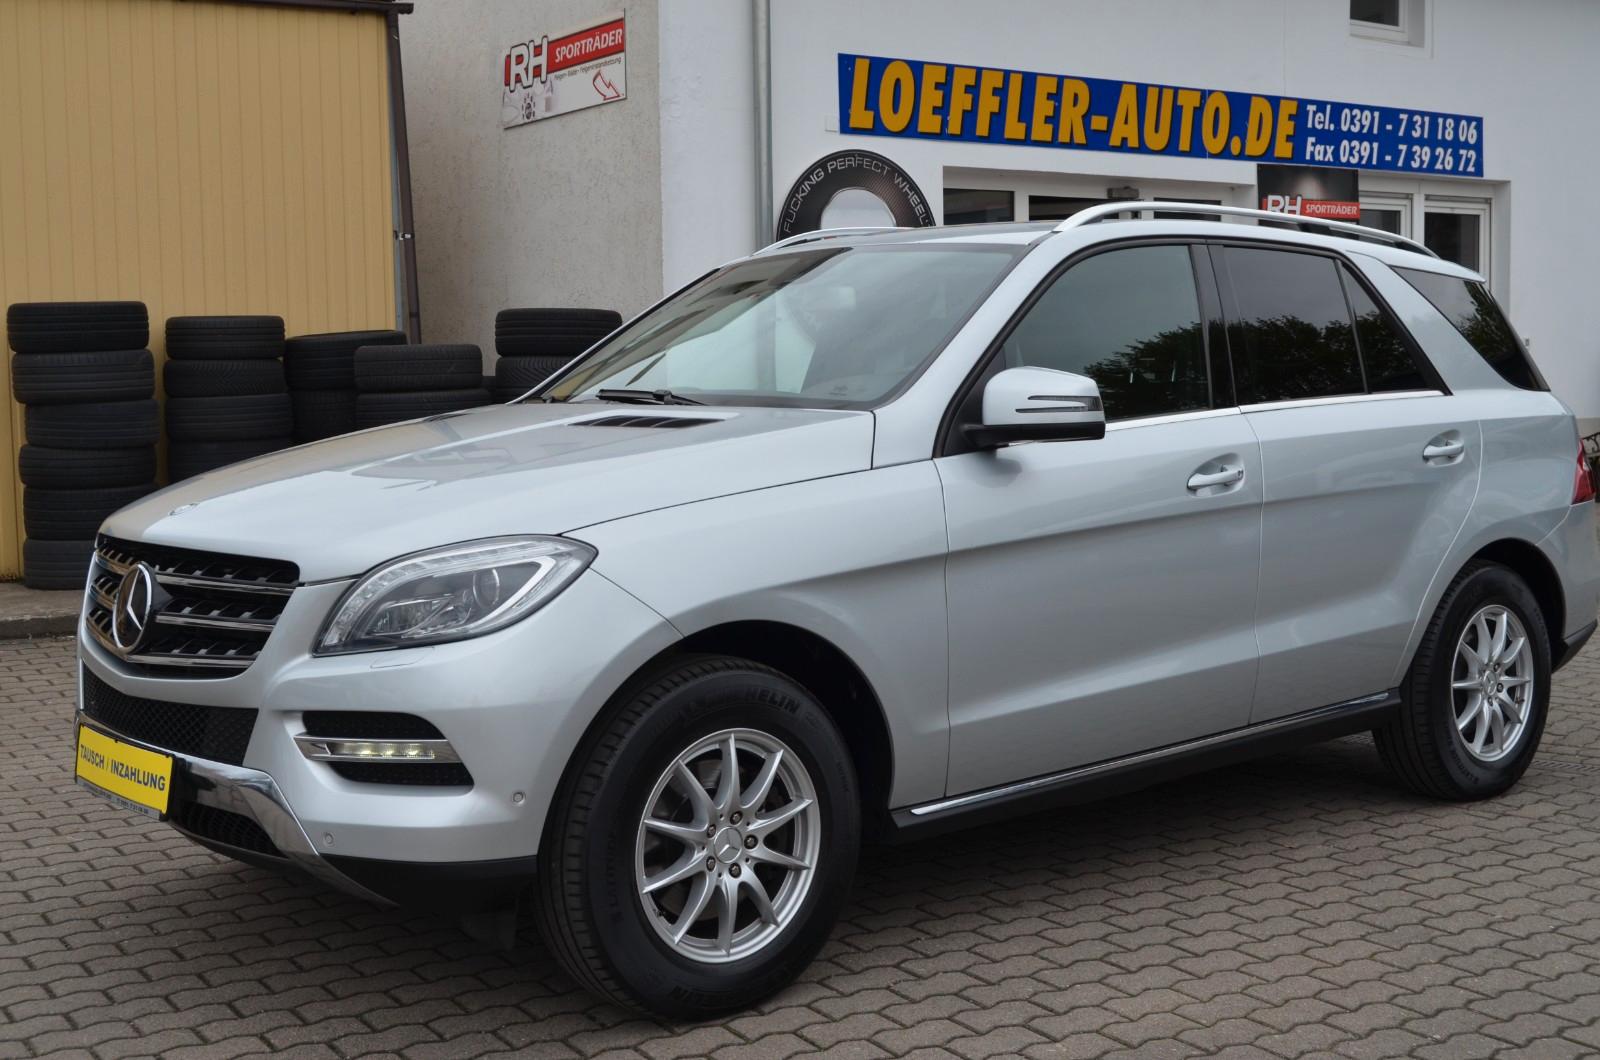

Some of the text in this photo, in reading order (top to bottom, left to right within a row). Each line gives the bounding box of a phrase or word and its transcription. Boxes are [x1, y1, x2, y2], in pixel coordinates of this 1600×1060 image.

[509, 35, 549, 93] RH
[555, 28, 623, 63] SPORTRÄDER
[848, 57, 1298, 158] LOEFFLER-AUTO.DE
[1306, 104, 1335, 131] Tel.
[1340, 107, 1380, 135] 0391
[1398, 113, 1408, 136] 7
[1411, 114, 1430, 140] 31
[1437, 117, 1454, 141] 18
[1458, 119, 1478, 145] 06
[1305, 136, 1335, 162] Fax
[1339, 139, 1379, 165] 0391
[1397, 144, 1408, 167] 7
[1410, 145, 1431, 169] 39
[1434, 147, 1454, 170] 26
[1457, 149, 1477, 172] 72
[783, 168, 825, 233] FUCKING
[827, 156, 891, 177] PERFECT
[80, 743, 105, 769] TAUSCH
[110, 759, 166, 792] INZAHLUNG
